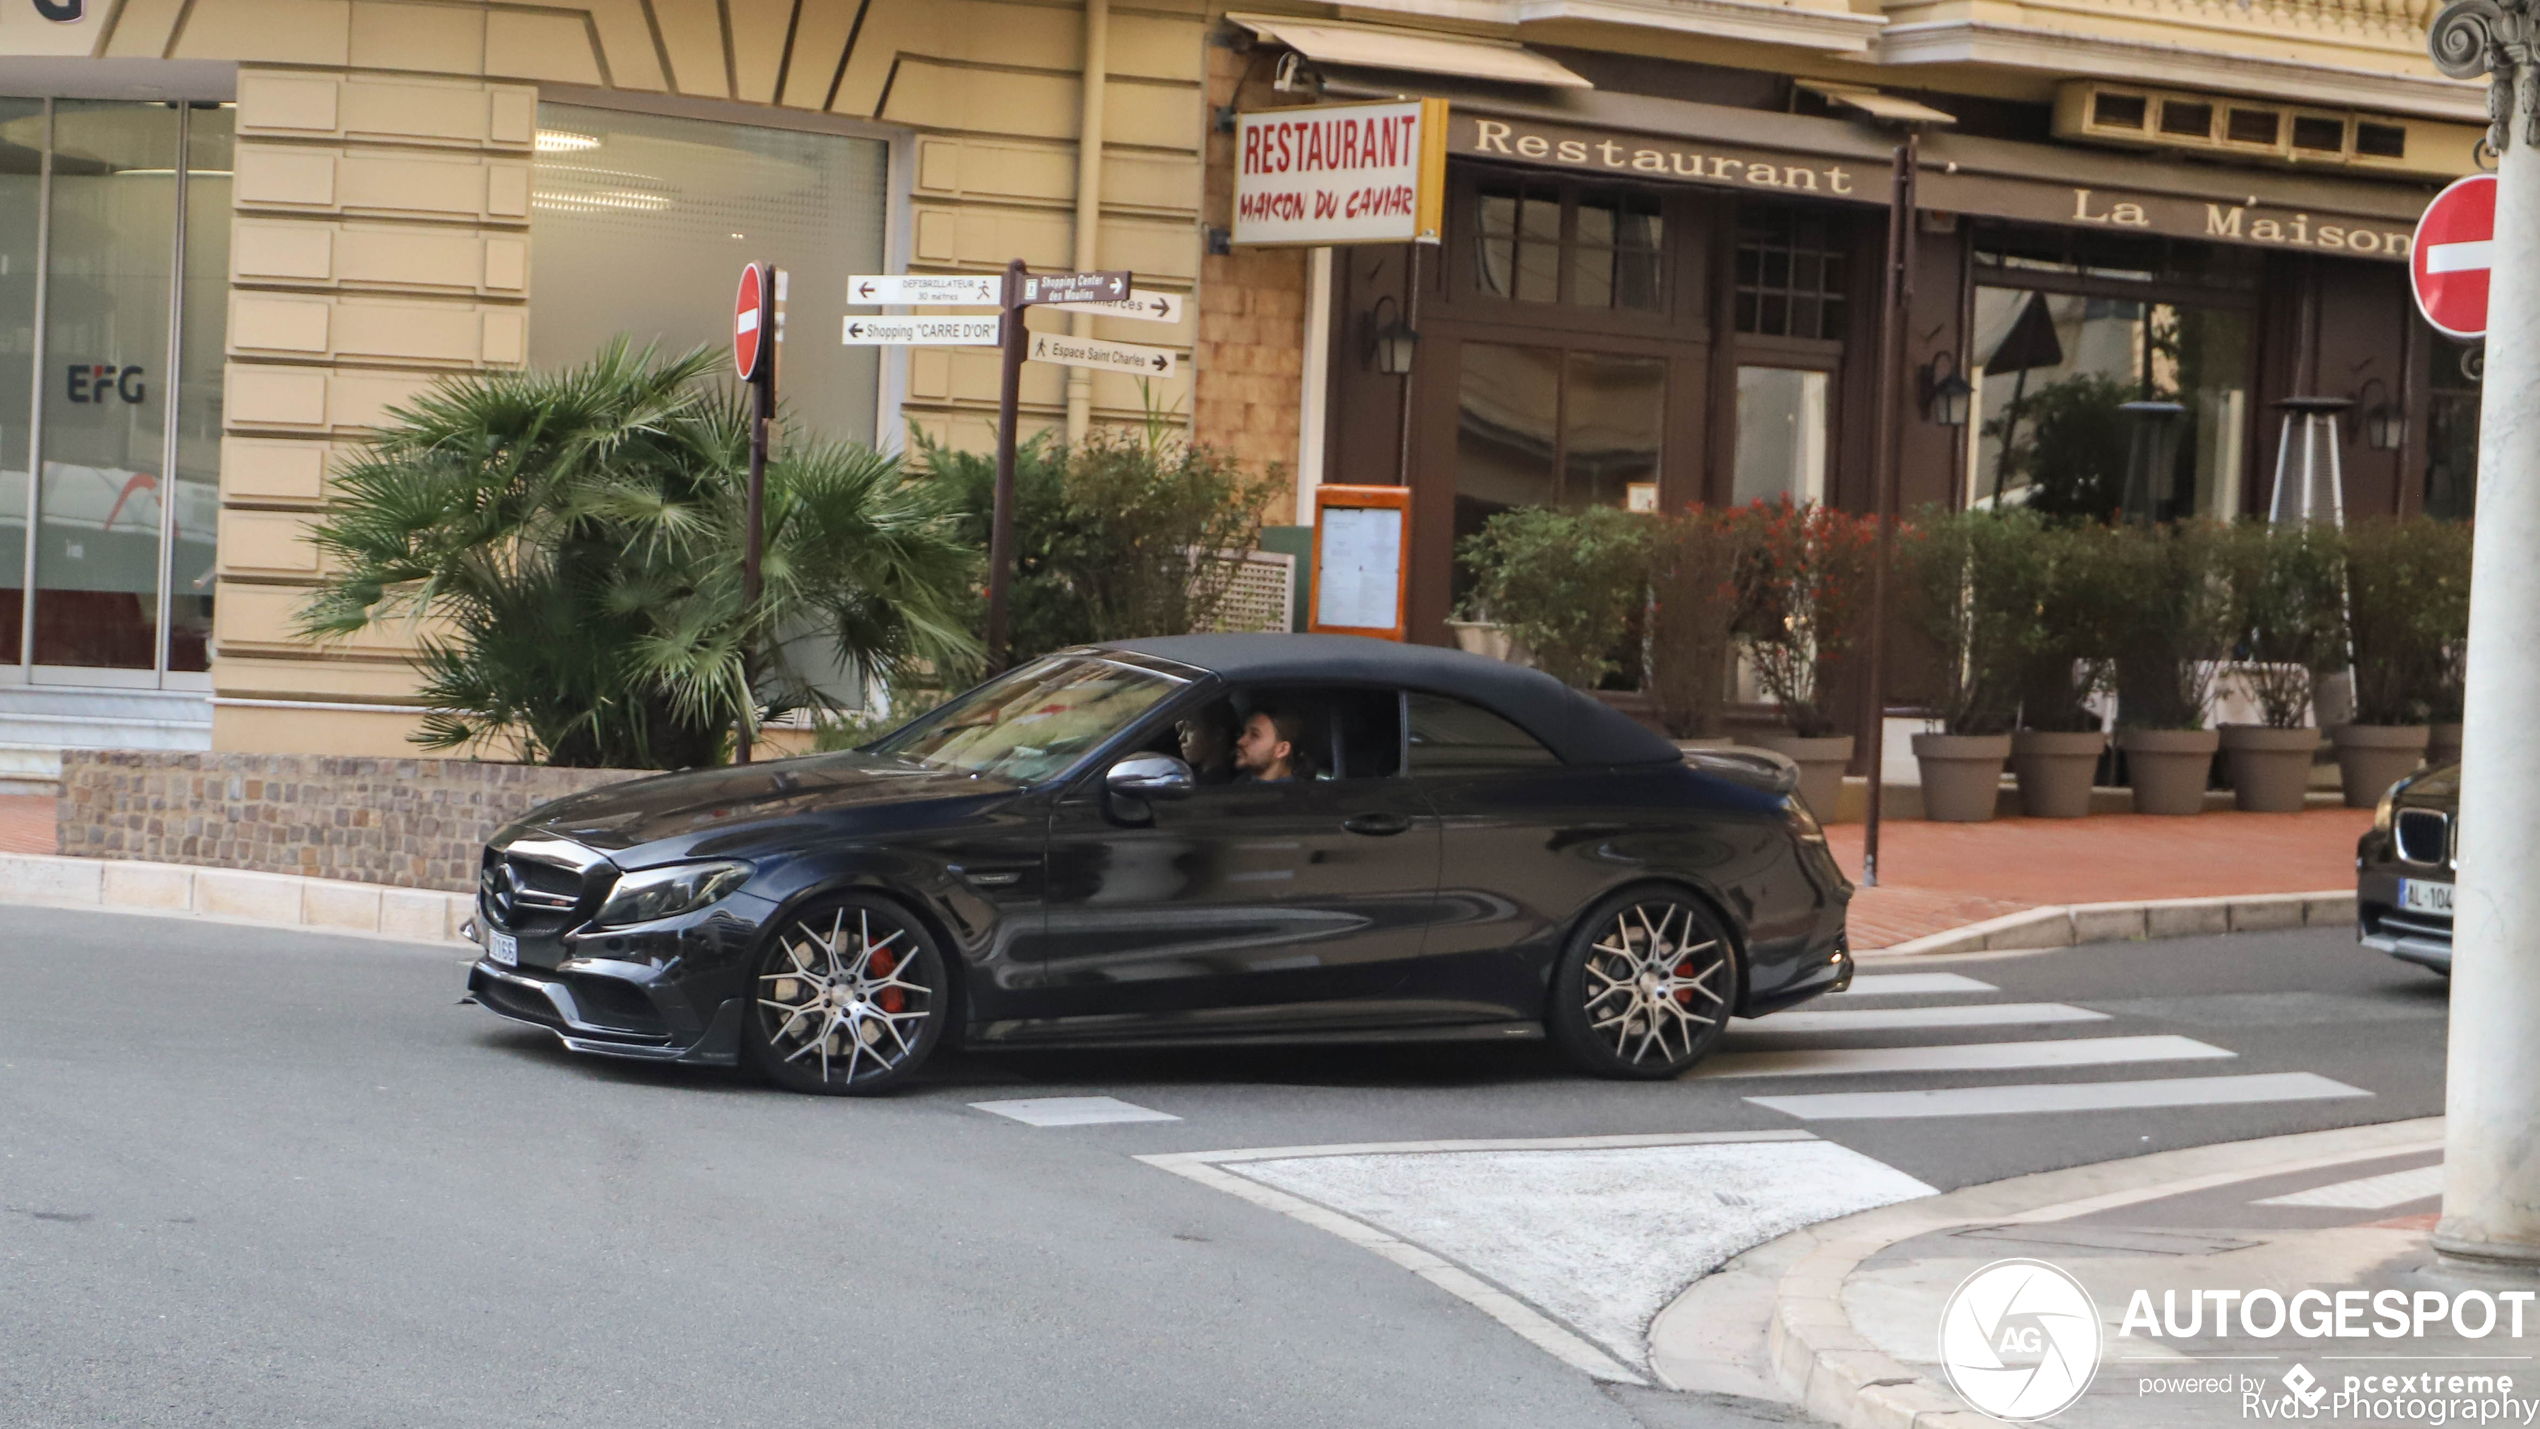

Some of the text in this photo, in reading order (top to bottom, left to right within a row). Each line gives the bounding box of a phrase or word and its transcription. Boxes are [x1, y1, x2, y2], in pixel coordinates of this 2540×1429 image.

[1244, 115, 1416, 175] RESTAURANT
[1475, 119, 1853, 196] Restaurant
[1239, 183, 1414, 223] MAISON DU CAVIAR
[2073, 188, 2413, 256] La Maison
[917, 292, 928, 300] 30
[1041, 274, 1104, 289] Shopping Center
[1048, 289, 1094, 301] des Moulins
[866, 323, 996, 341] Shopping "CARRE D'OR"
[1052, 342, 1146, 367] Espace Saint Charles
[67, 364, 145, 404] EFG
